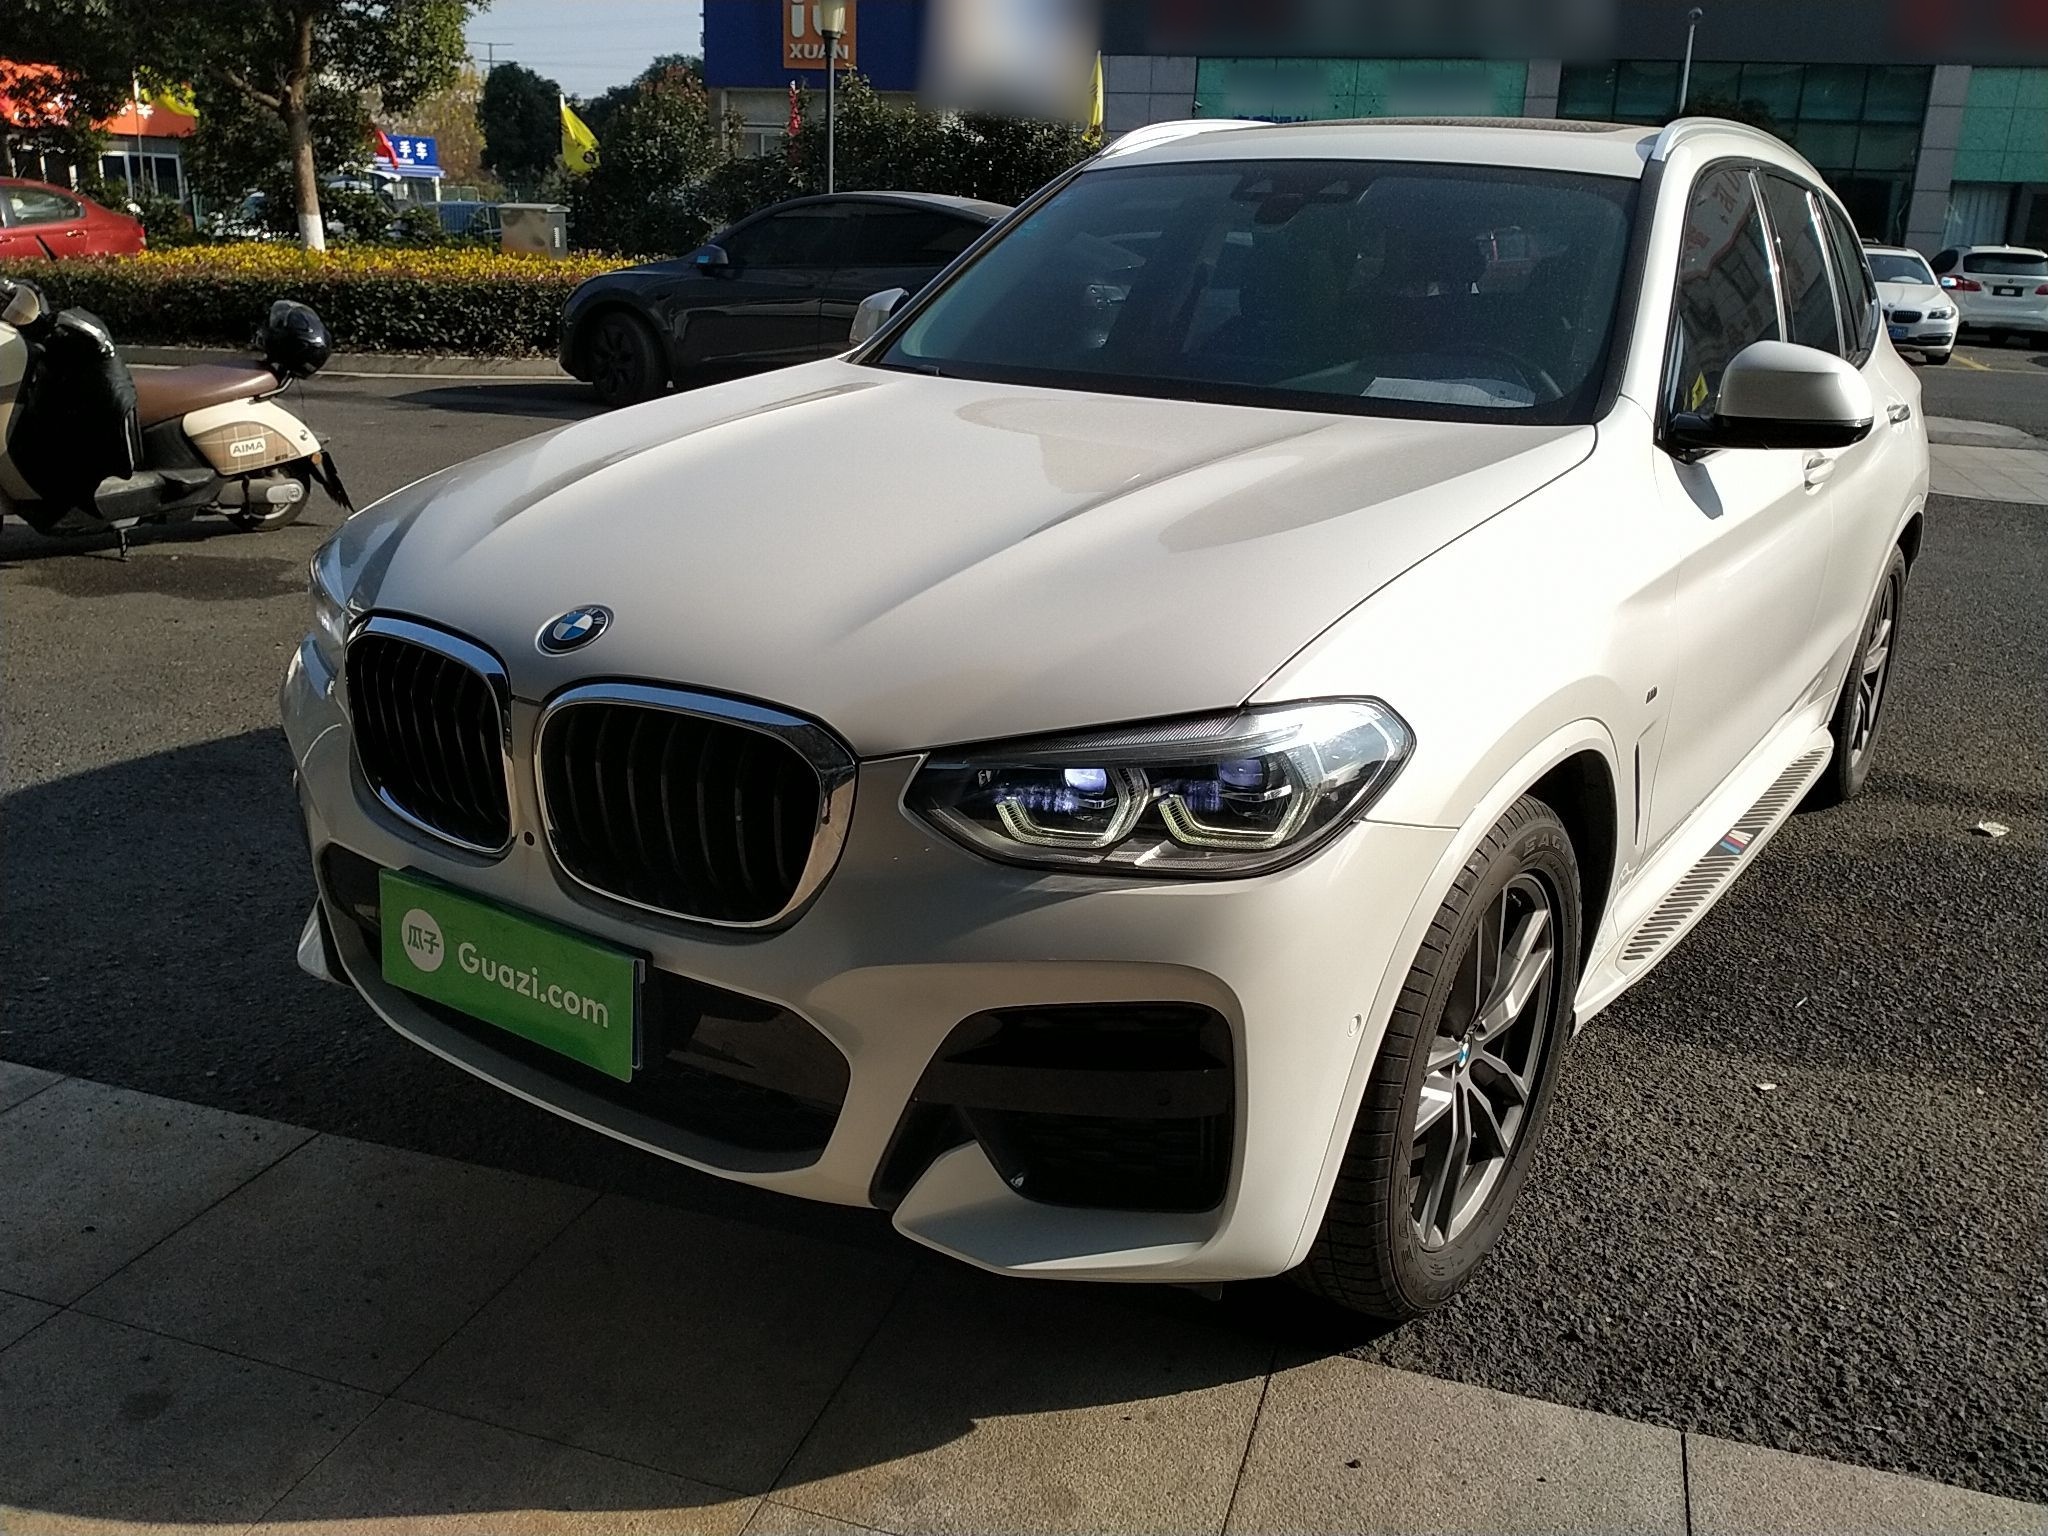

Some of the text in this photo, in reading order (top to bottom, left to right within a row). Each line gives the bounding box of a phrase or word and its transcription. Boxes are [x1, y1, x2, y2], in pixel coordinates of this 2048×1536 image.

[789, 43, 849, 60] XUAN
[387, 140, 428, 160] 手车
[232, 441, 264, 455] AIMA
[407, 924, 440, 955] 瓜子
[457, 942, 609, 1029] Guazi.com
